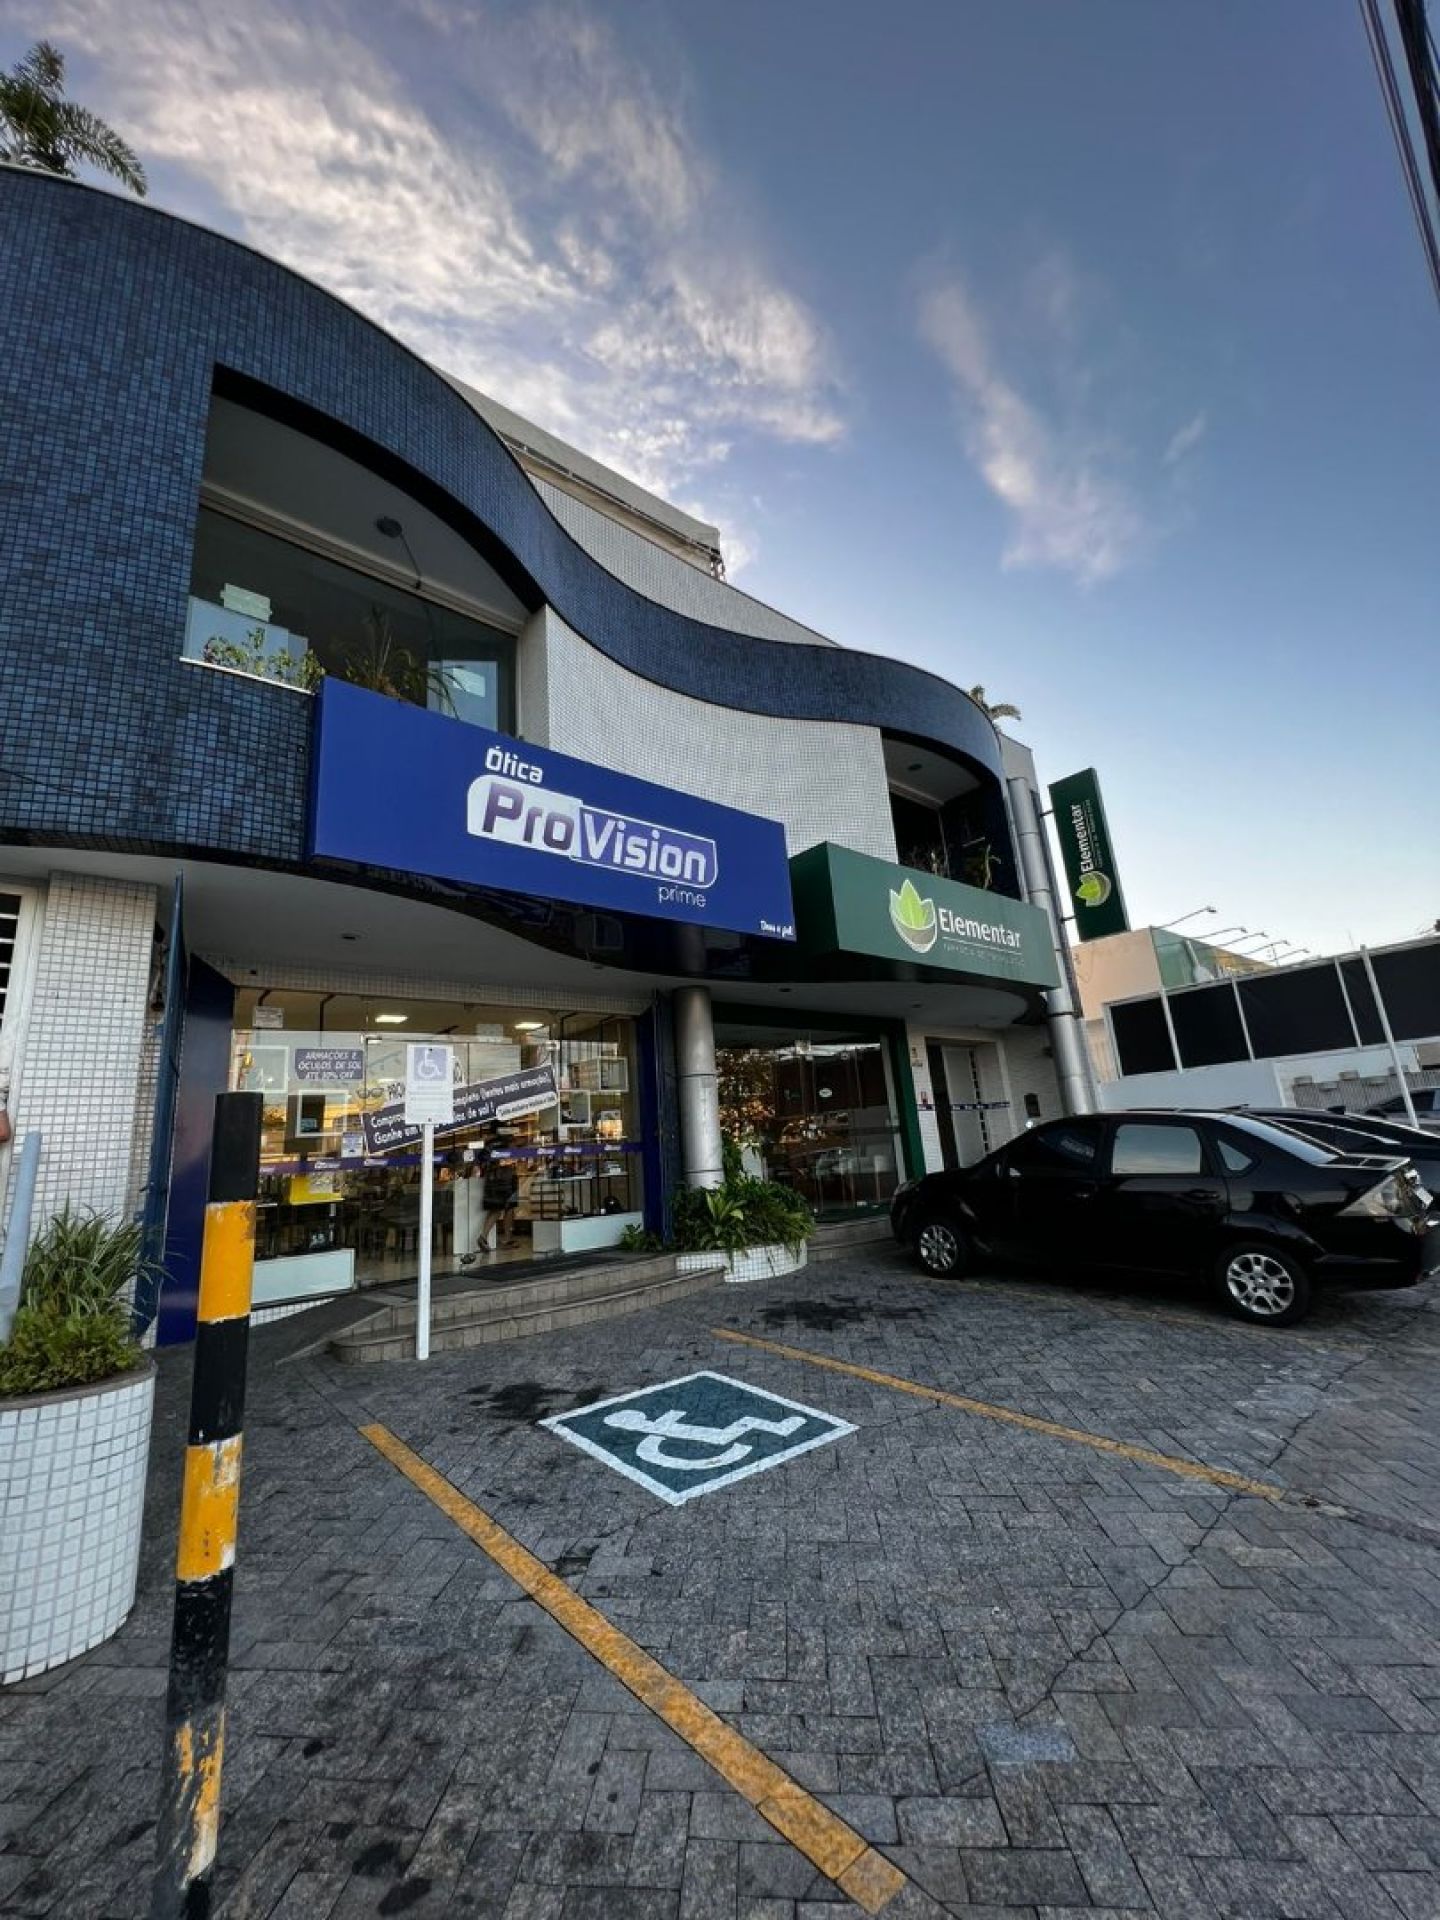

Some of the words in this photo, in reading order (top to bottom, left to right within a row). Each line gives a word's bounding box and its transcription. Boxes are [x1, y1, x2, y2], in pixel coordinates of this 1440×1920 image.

[485, 746, 543, 783] Ótica
[1070, 804, 1094, 872] Elementar
[658, 886, 707, 908] prime
[938, 907, 1021, 948] Elementar
[374, 1128, 403, 1144] Ganhe
